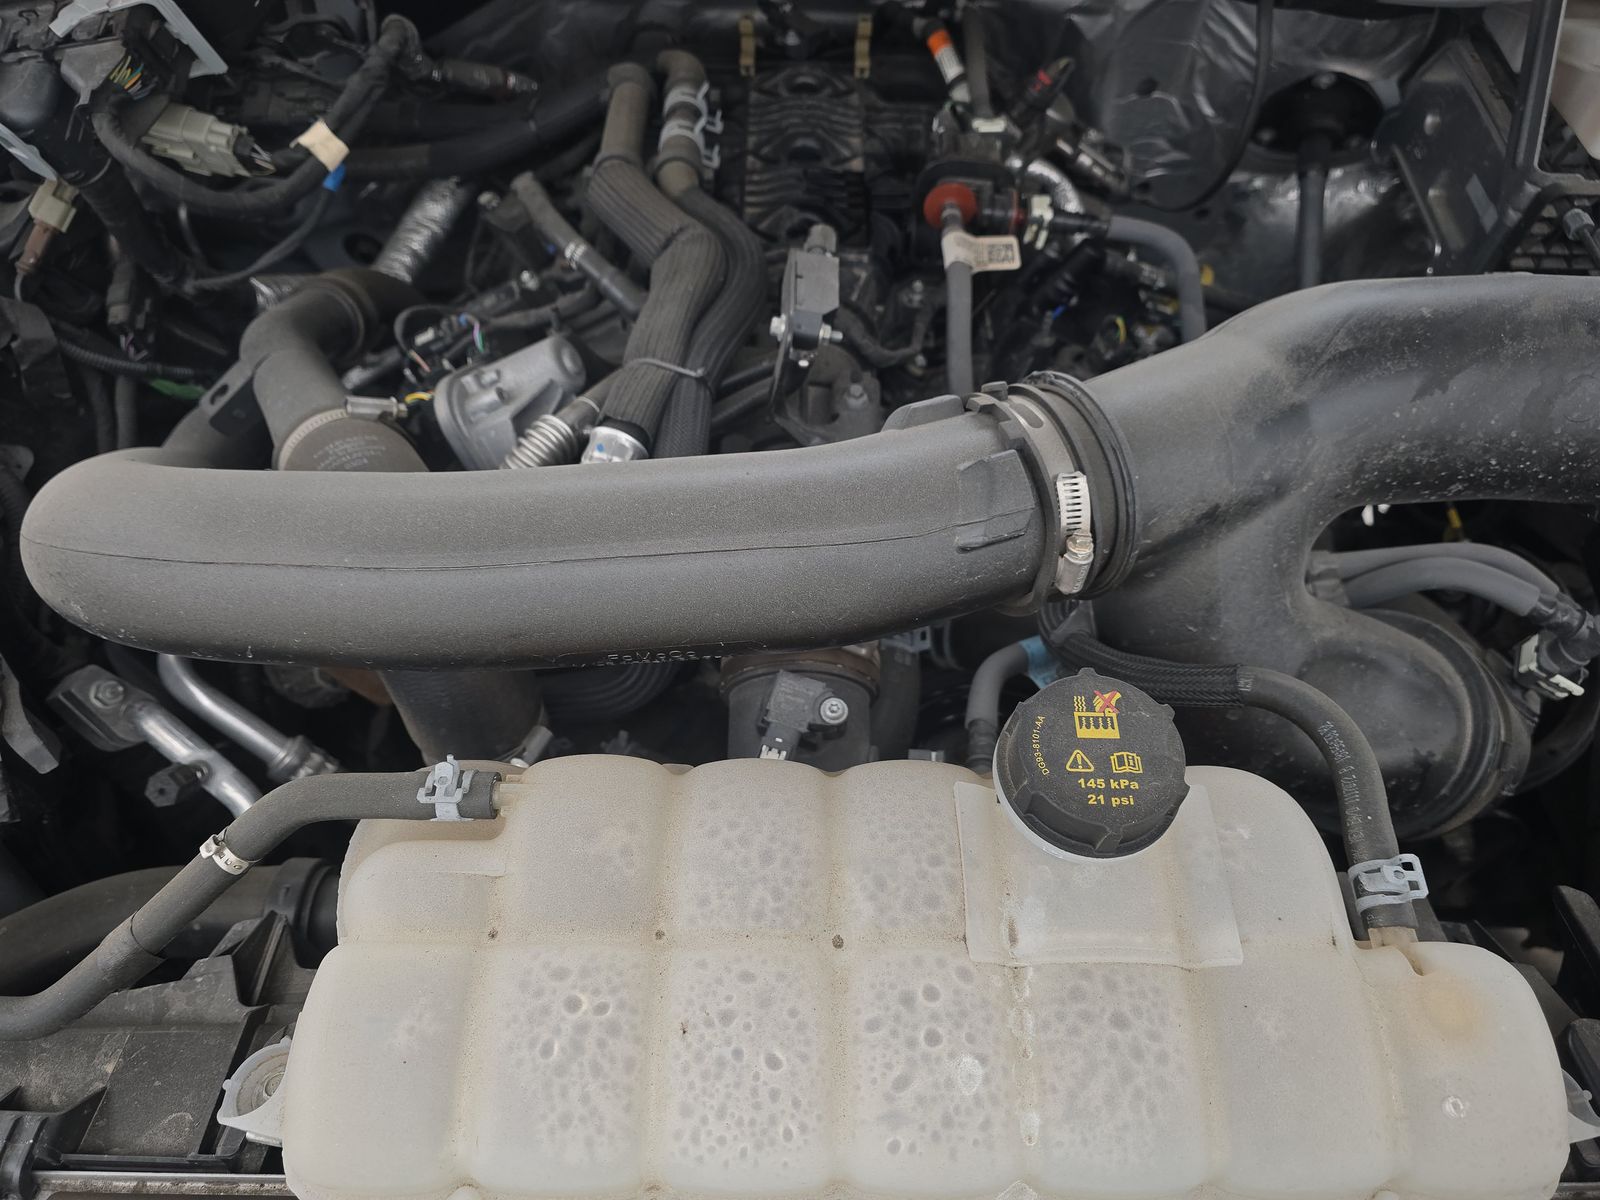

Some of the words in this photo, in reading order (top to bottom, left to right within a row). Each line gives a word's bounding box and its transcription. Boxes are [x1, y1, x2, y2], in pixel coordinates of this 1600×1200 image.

[1031, 715, 1050, 776] DG93-8101-AA
[1077, 778, 1105, 789] 145
[1110, 779, 1139, 790] kPa
[1087, 795, 1105, 805] 21
[1111, 795, 1134, 807] psi
